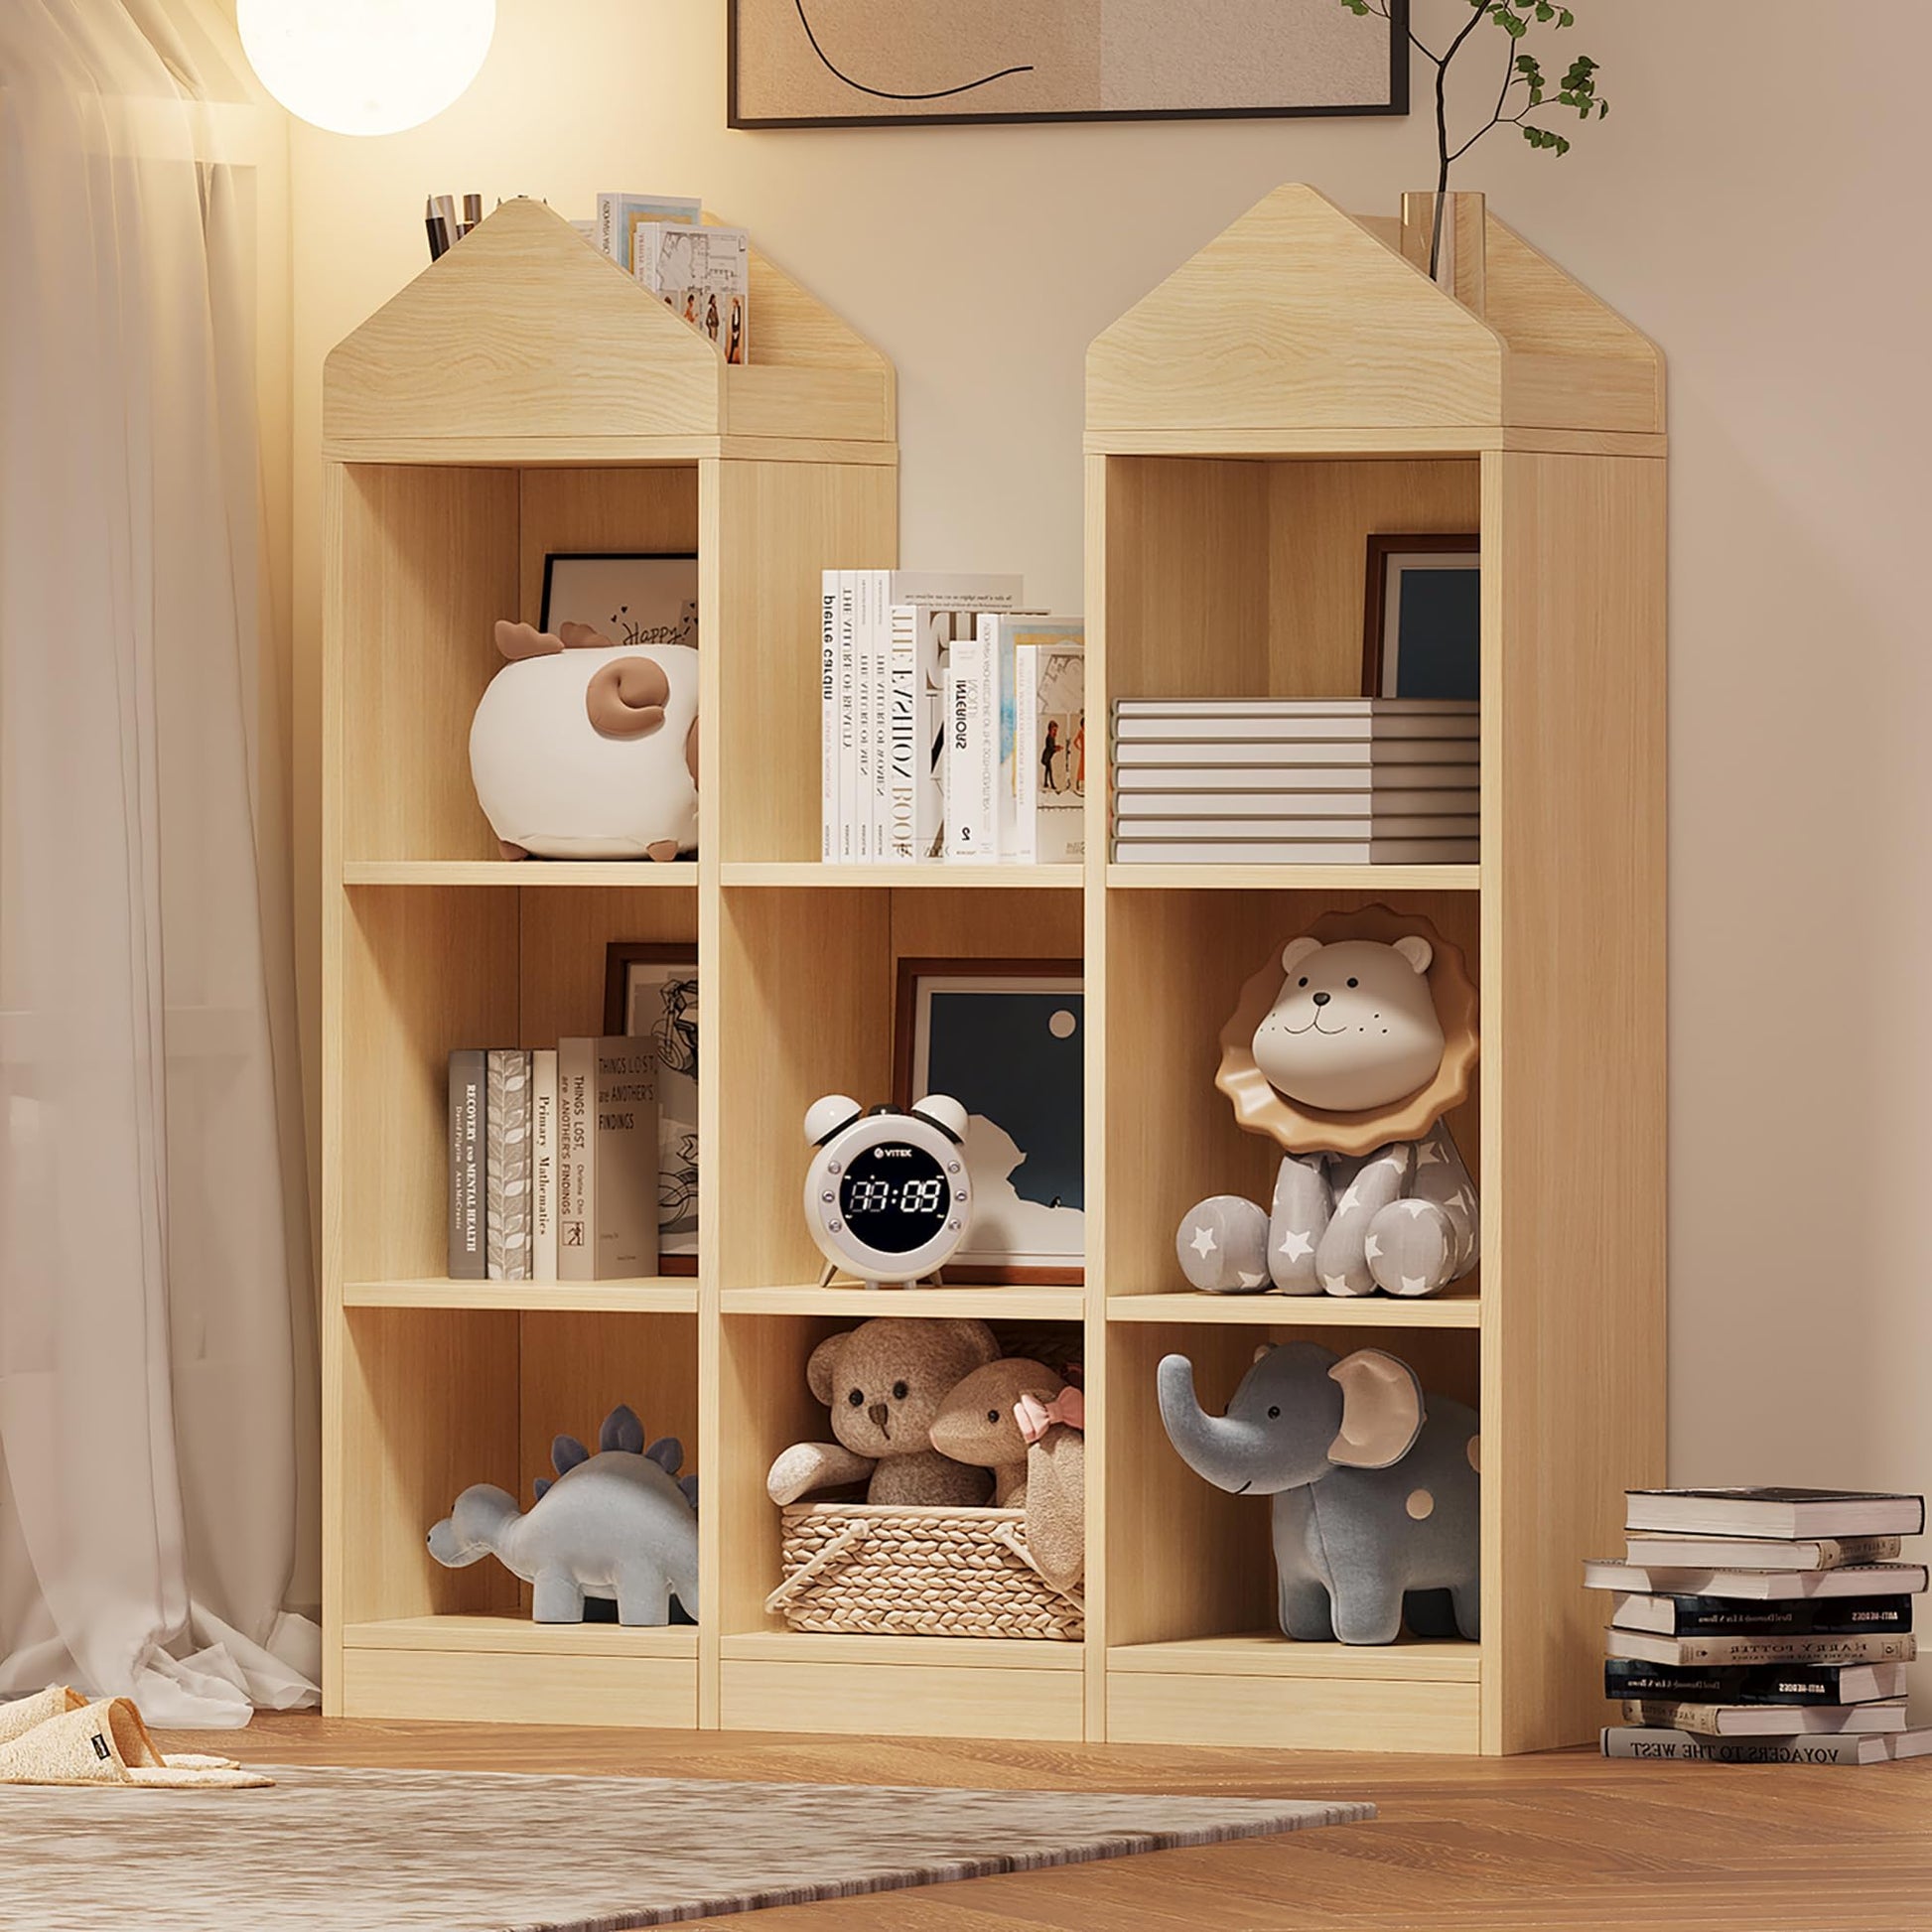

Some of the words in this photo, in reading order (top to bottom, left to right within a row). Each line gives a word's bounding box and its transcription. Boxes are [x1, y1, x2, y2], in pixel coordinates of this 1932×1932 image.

[599, 1057, 626, 1075] THINGS
[628, 1055, 658, 1075] LOST,
[466, 1084, 477, 1142] RECOVERY
[573, 1075, 584, 1116] THINGS
[611, 1084, 653, 1102] ANOTHER'S
[537, 1096, 549, 1147] Primary
[561, 1099, 570, 1160] ANOTHER'S
[572, 1122, 584, 1150] LOST,
[599, 1112, 634, 1130] FINDINGS
[466, 1163, 477, 1208] MENTAL
[539, 1156, 550, 1236] Mathematics
[561, 1164, 570, 1215] FINDINGS
[466, 1208, 477, 1252] HEALTH
